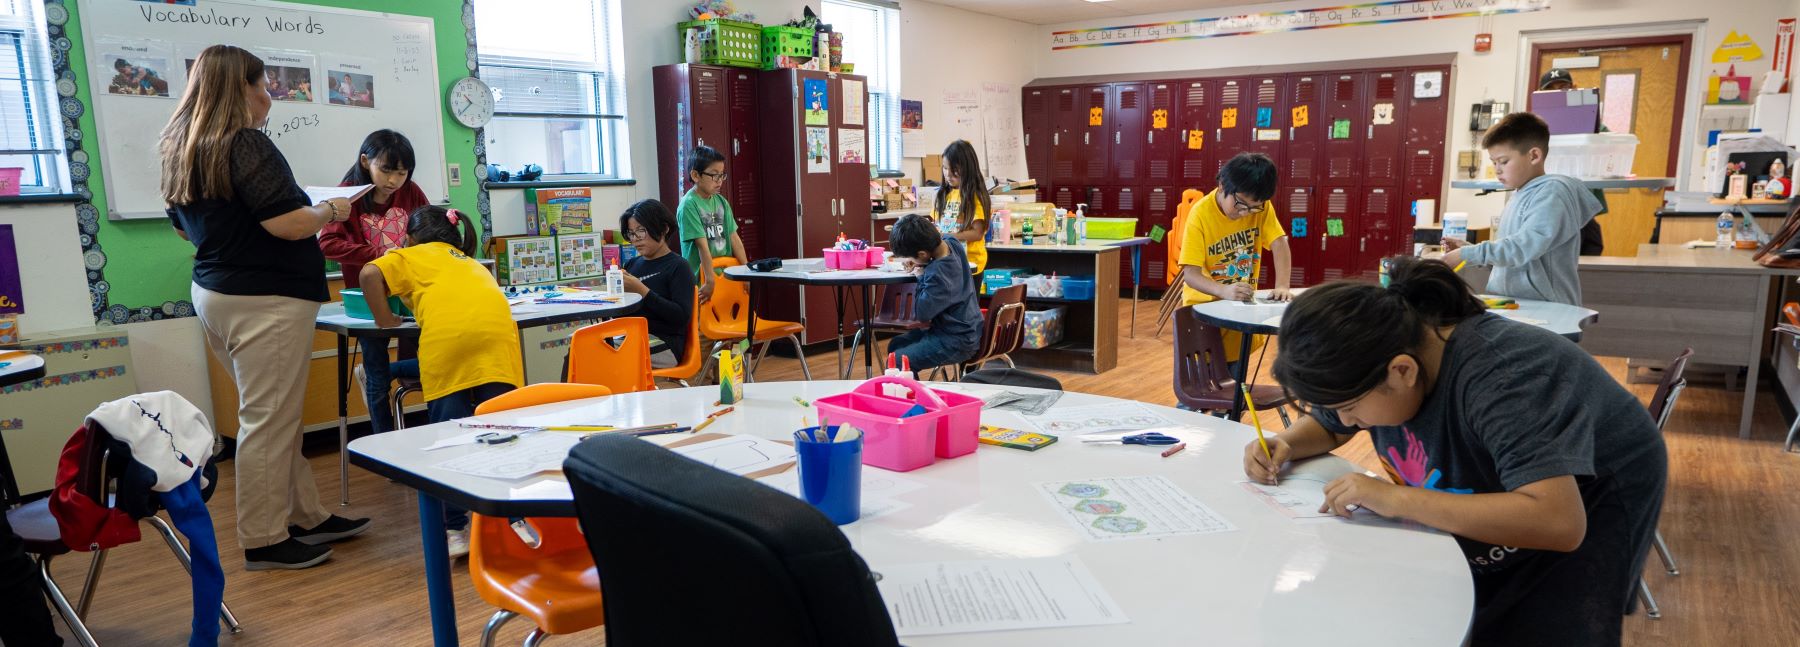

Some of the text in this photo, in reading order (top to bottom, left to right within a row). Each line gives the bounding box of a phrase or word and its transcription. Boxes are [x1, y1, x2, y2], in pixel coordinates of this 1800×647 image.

[140, 5, 325, 35] Vocabulary Words
[1309, 12, 1320, 24] Pp
[1328, 11, 1342, 23] Qq
[283, 113, 320, 133] 2023
